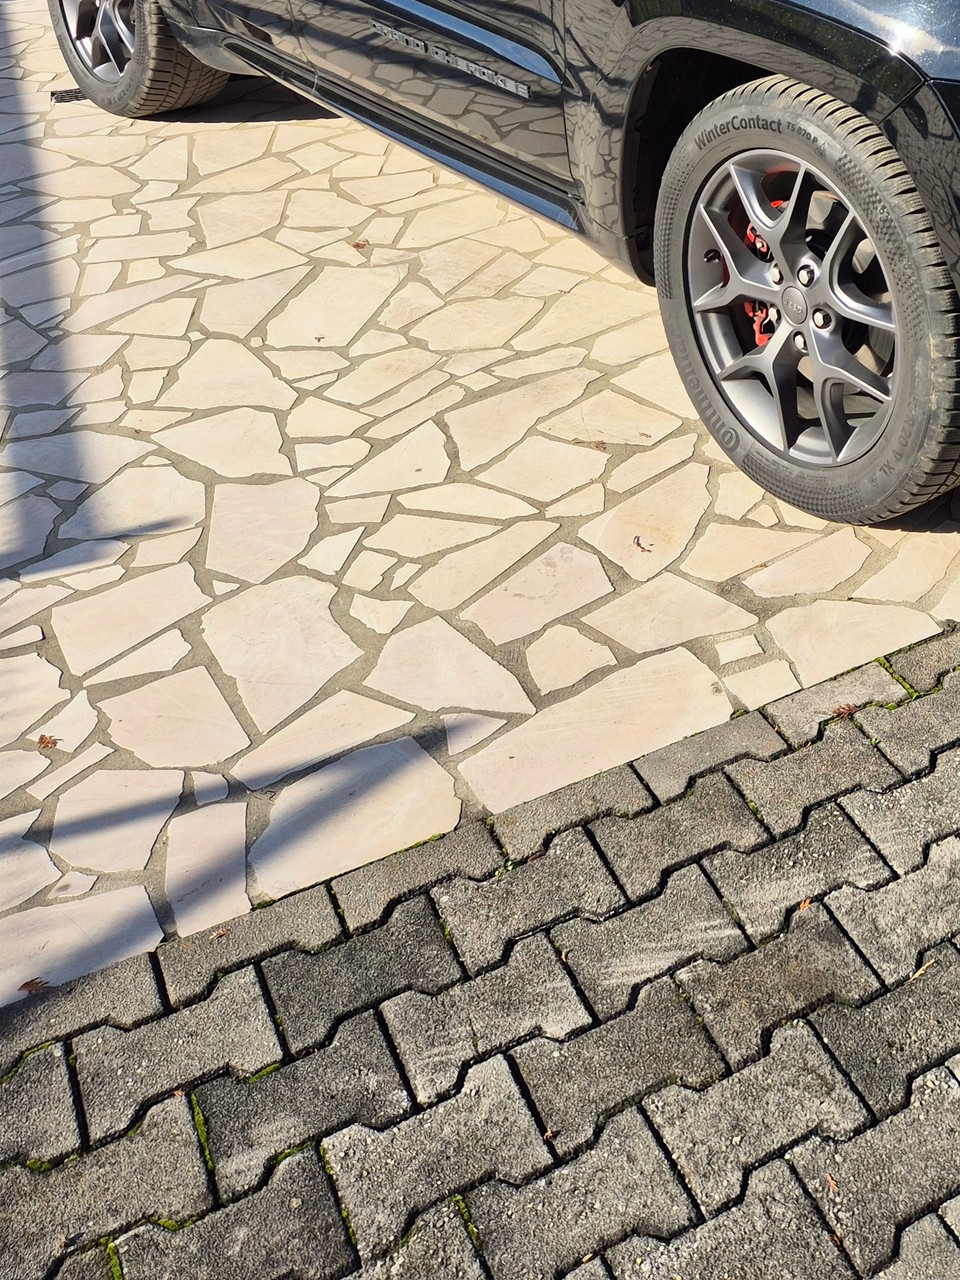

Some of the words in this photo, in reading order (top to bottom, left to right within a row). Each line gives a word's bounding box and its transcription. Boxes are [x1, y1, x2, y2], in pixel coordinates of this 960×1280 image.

[369, 20, 428, 54] GRAND
[431, 46, 532, 99] CHEROKEE
[694, 115, 783, 150] WinterContact
[786, 121, 796, 132] TS
[796, 126, 812, 140] 870
[669, 328, 740, 453] Continental
